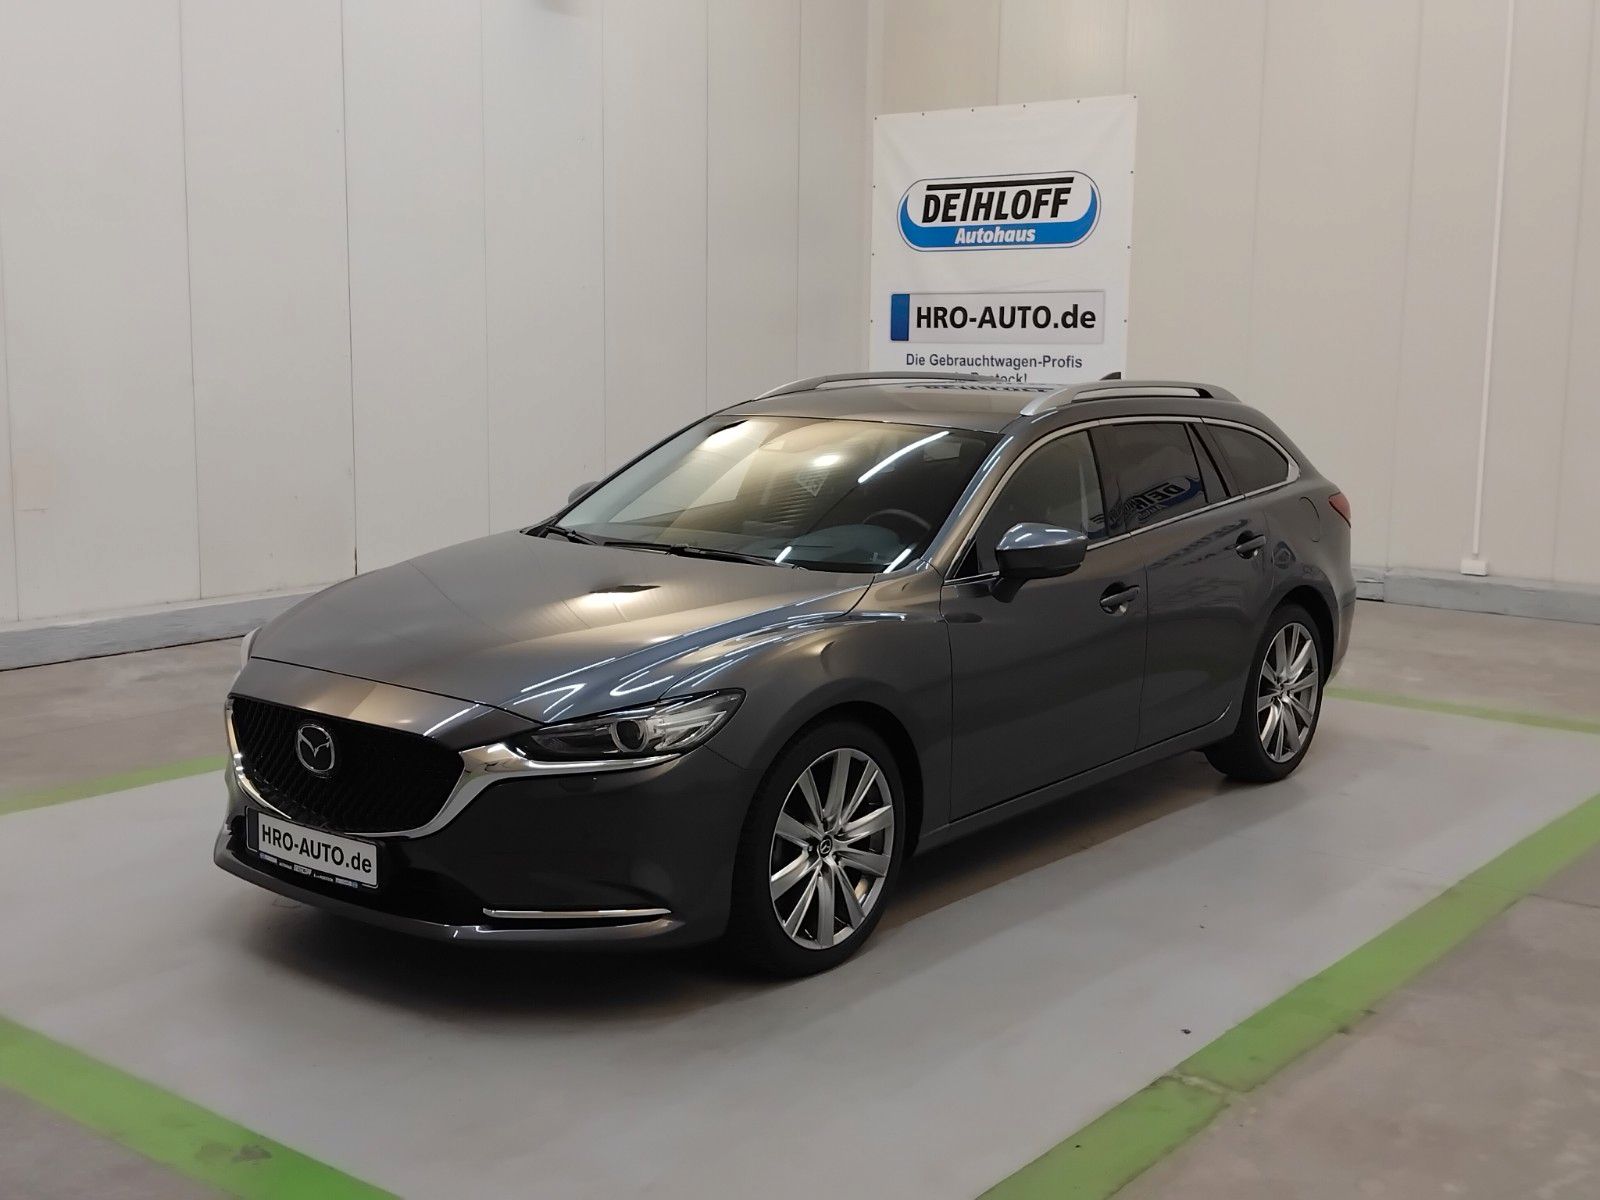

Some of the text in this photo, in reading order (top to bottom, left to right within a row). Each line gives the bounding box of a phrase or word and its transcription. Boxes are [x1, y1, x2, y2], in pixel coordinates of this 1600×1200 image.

[921, 176, 1075, 224] DETHLOFF
[954, 226, 1036, 245] Autohaus
[915, 304, 1097, 330] HRO-AUTO.de
[905, 353, 1083, 369] Die Gebrauchtwagen-Profis
[261, 823, 373, 874] HRO-AUTO.de
